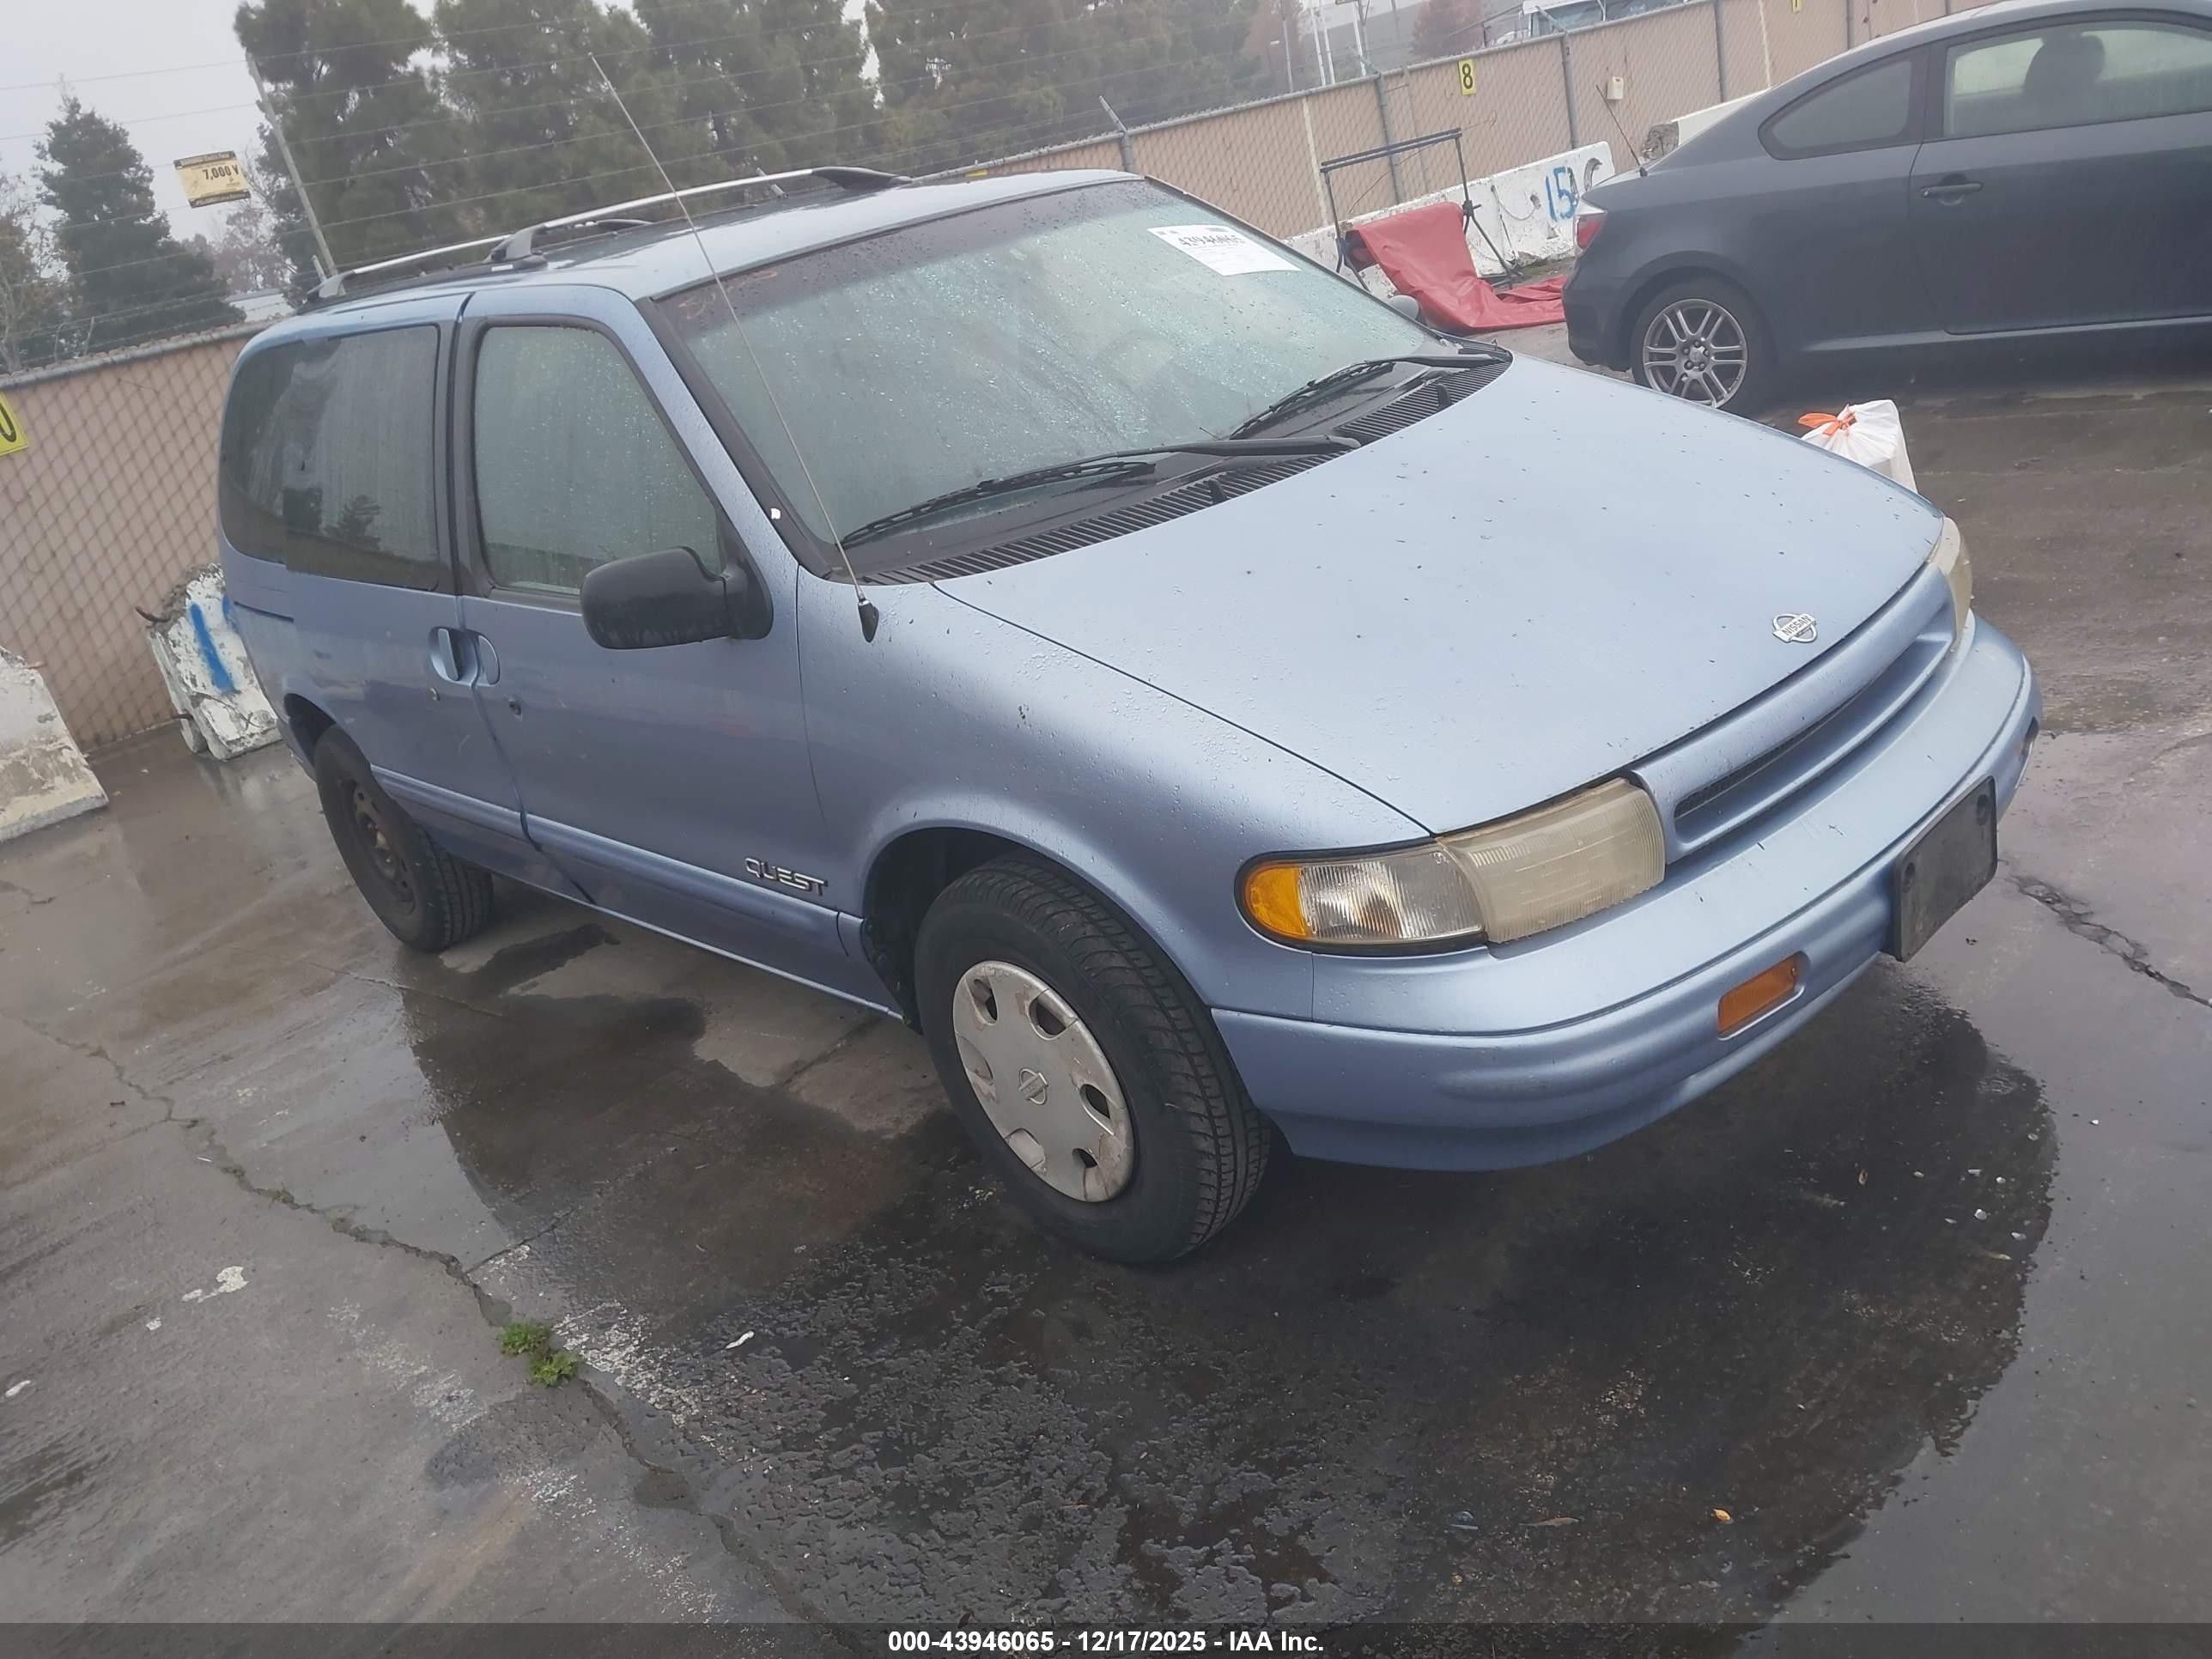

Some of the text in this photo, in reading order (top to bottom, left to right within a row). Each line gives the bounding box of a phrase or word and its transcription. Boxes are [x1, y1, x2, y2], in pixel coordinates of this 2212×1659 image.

[1462, 63, 1474, 89] 8
[202, 166, 232, 180] 7,000
[1782, 615, 1813, 636] NISSAN
[744, 857, 826, 896] QUEST
